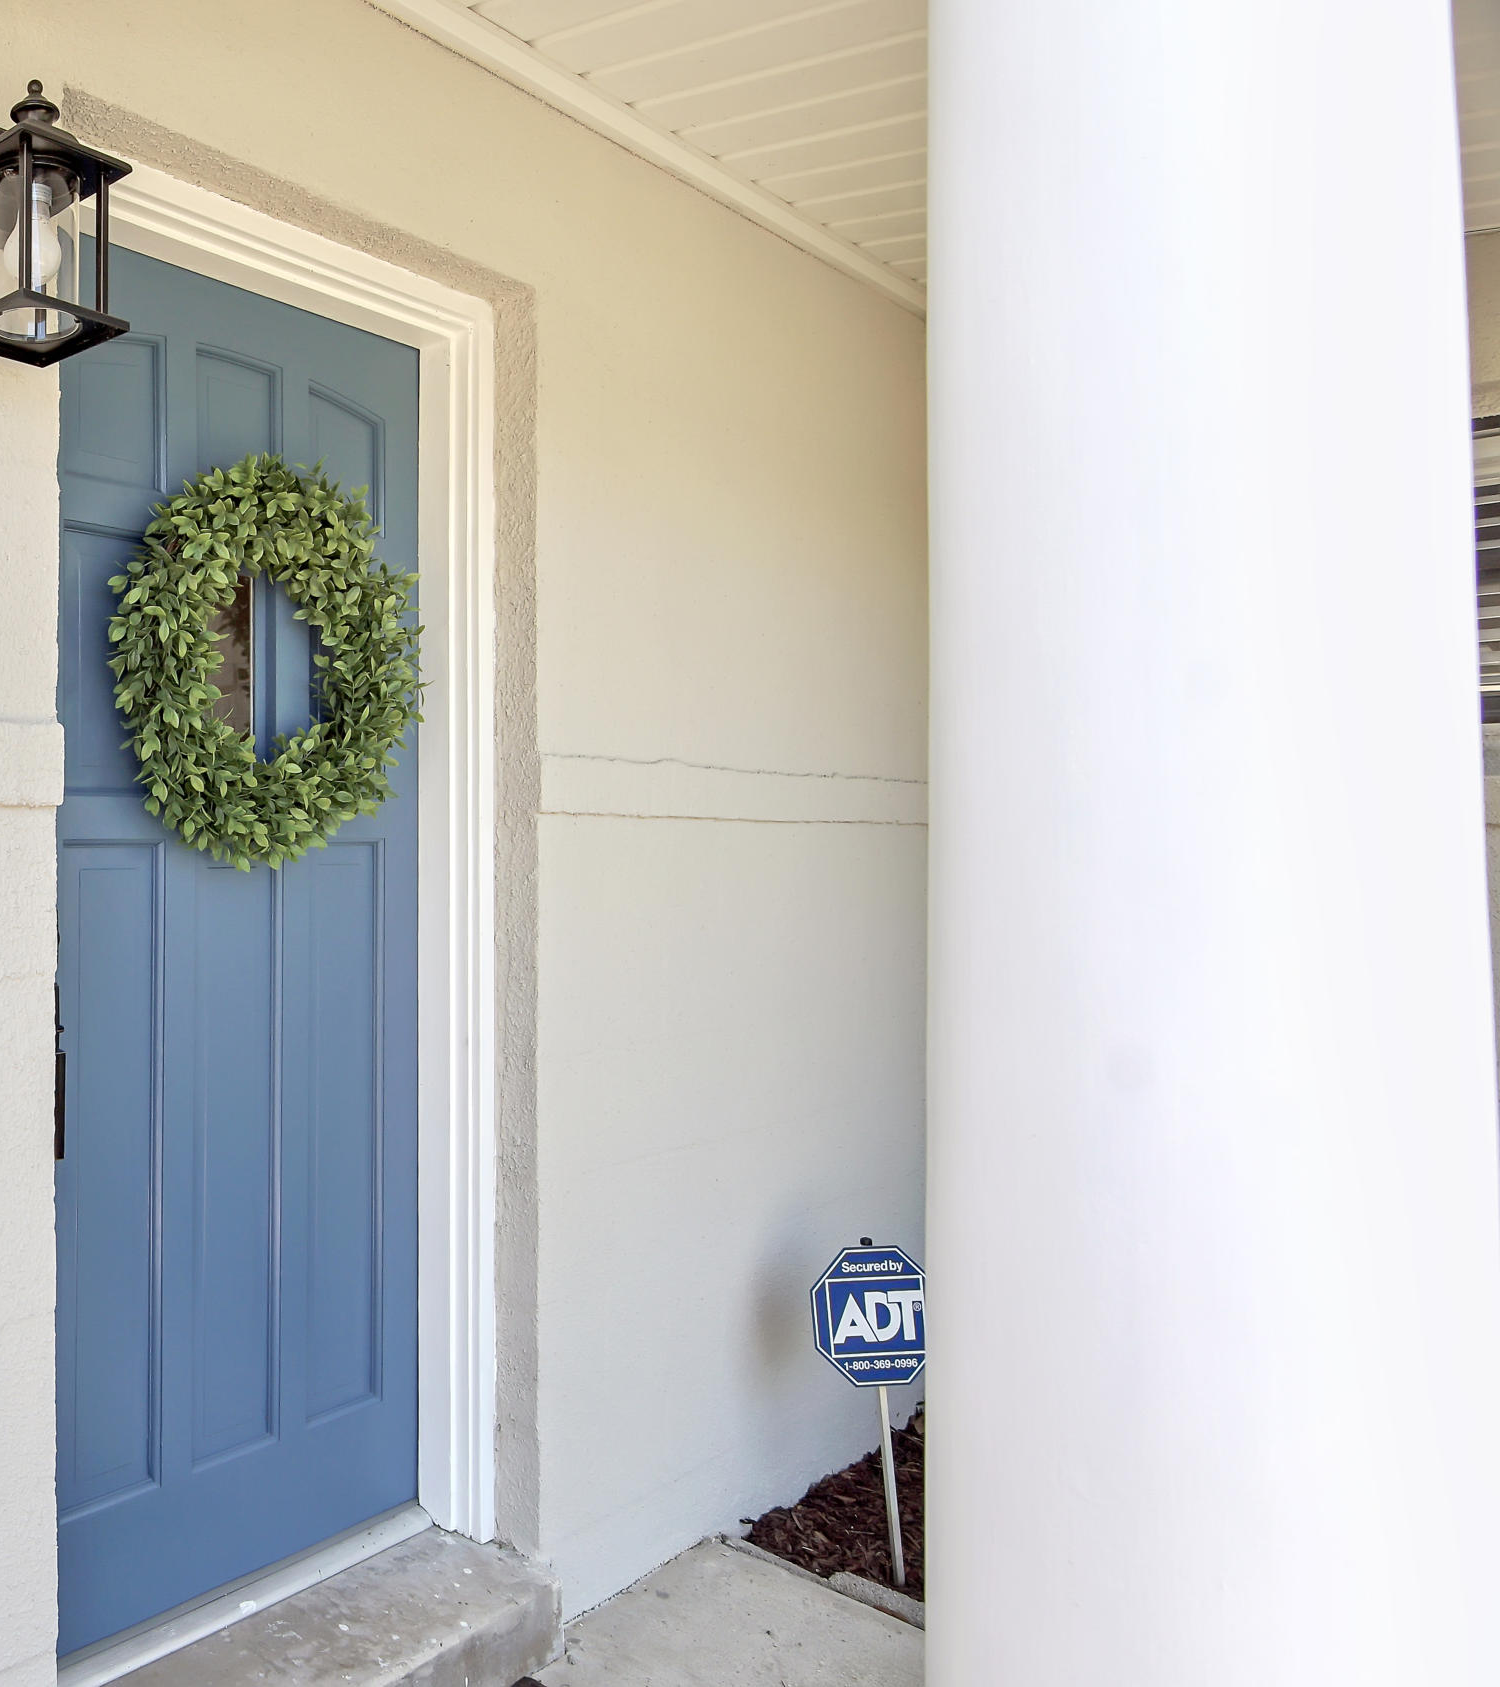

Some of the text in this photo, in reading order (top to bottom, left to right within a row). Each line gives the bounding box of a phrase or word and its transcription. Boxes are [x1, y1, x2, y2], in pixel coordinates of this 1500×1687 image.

[841, 1260, 903, 1273] Secured by
[844, 1358, 918, 1371] 1-800-369-0996
